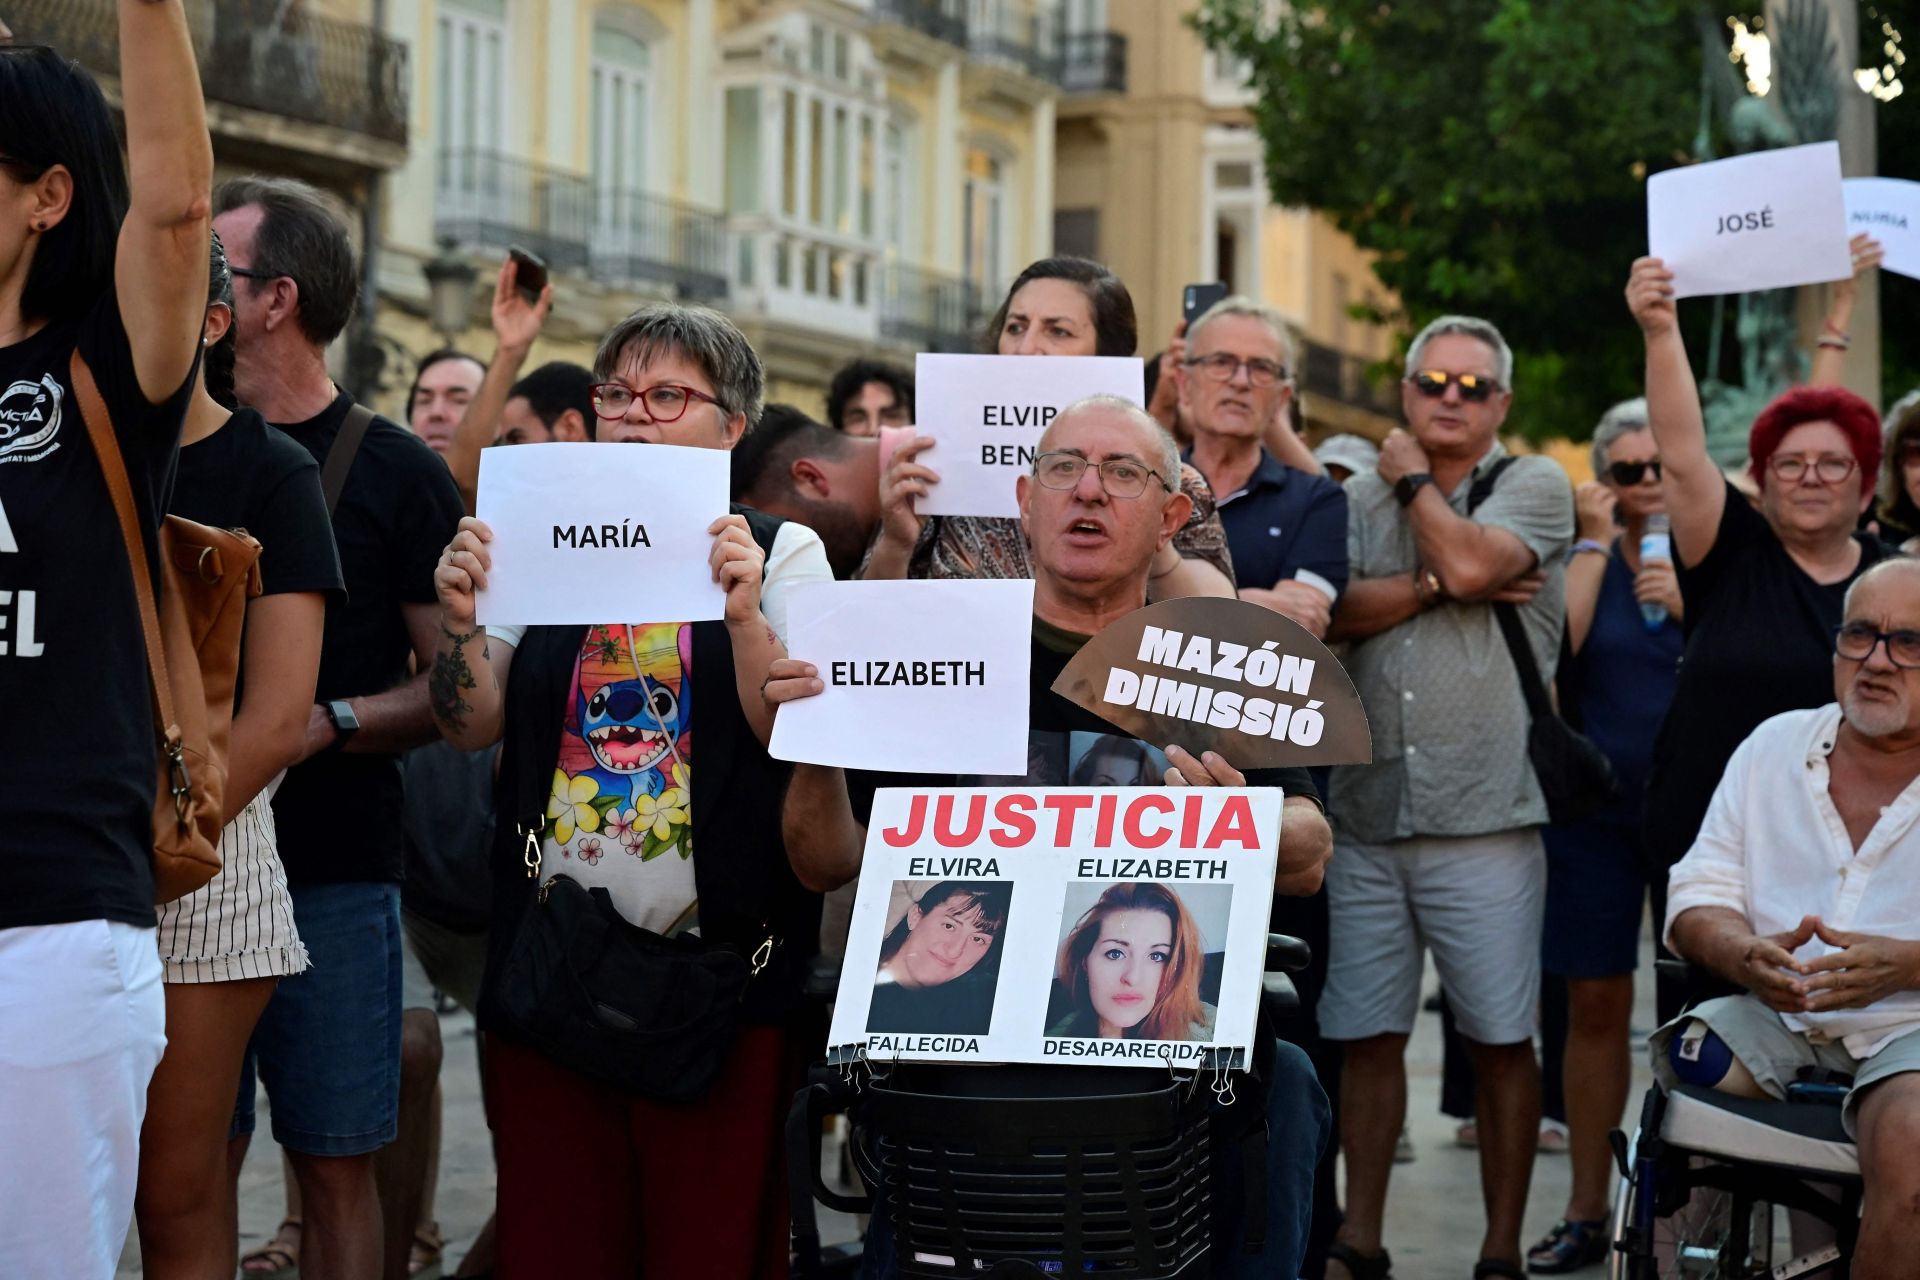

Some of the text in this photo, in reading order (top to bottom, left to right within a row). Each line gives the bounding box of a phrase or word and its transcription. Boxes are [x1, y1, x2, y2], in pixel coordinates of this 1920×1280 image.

[1717, 204, 1774, 235] JOSÉ
[983, 405, 1058, 426] ELVIR
[981, 444, 1036, 465] BEN
[553, 518, 652, 548] MARÍA
[1137, 625, 1316, 696] MAZÓN
[831, 661, 985, 686] ELIZABETH
[1103, 667, 1325, 747] DIMISSIÓ
[882, 794, 1261, 850] JUSTICIA
[908, 857, 1001, 877] ELVIRA
[1077, 858, 1228, 880] ELIZABETH
[868, 1036, 980, 1053] FALLECIDA
[1043, 1040, 1204, 1060] DESAPARECIDA
